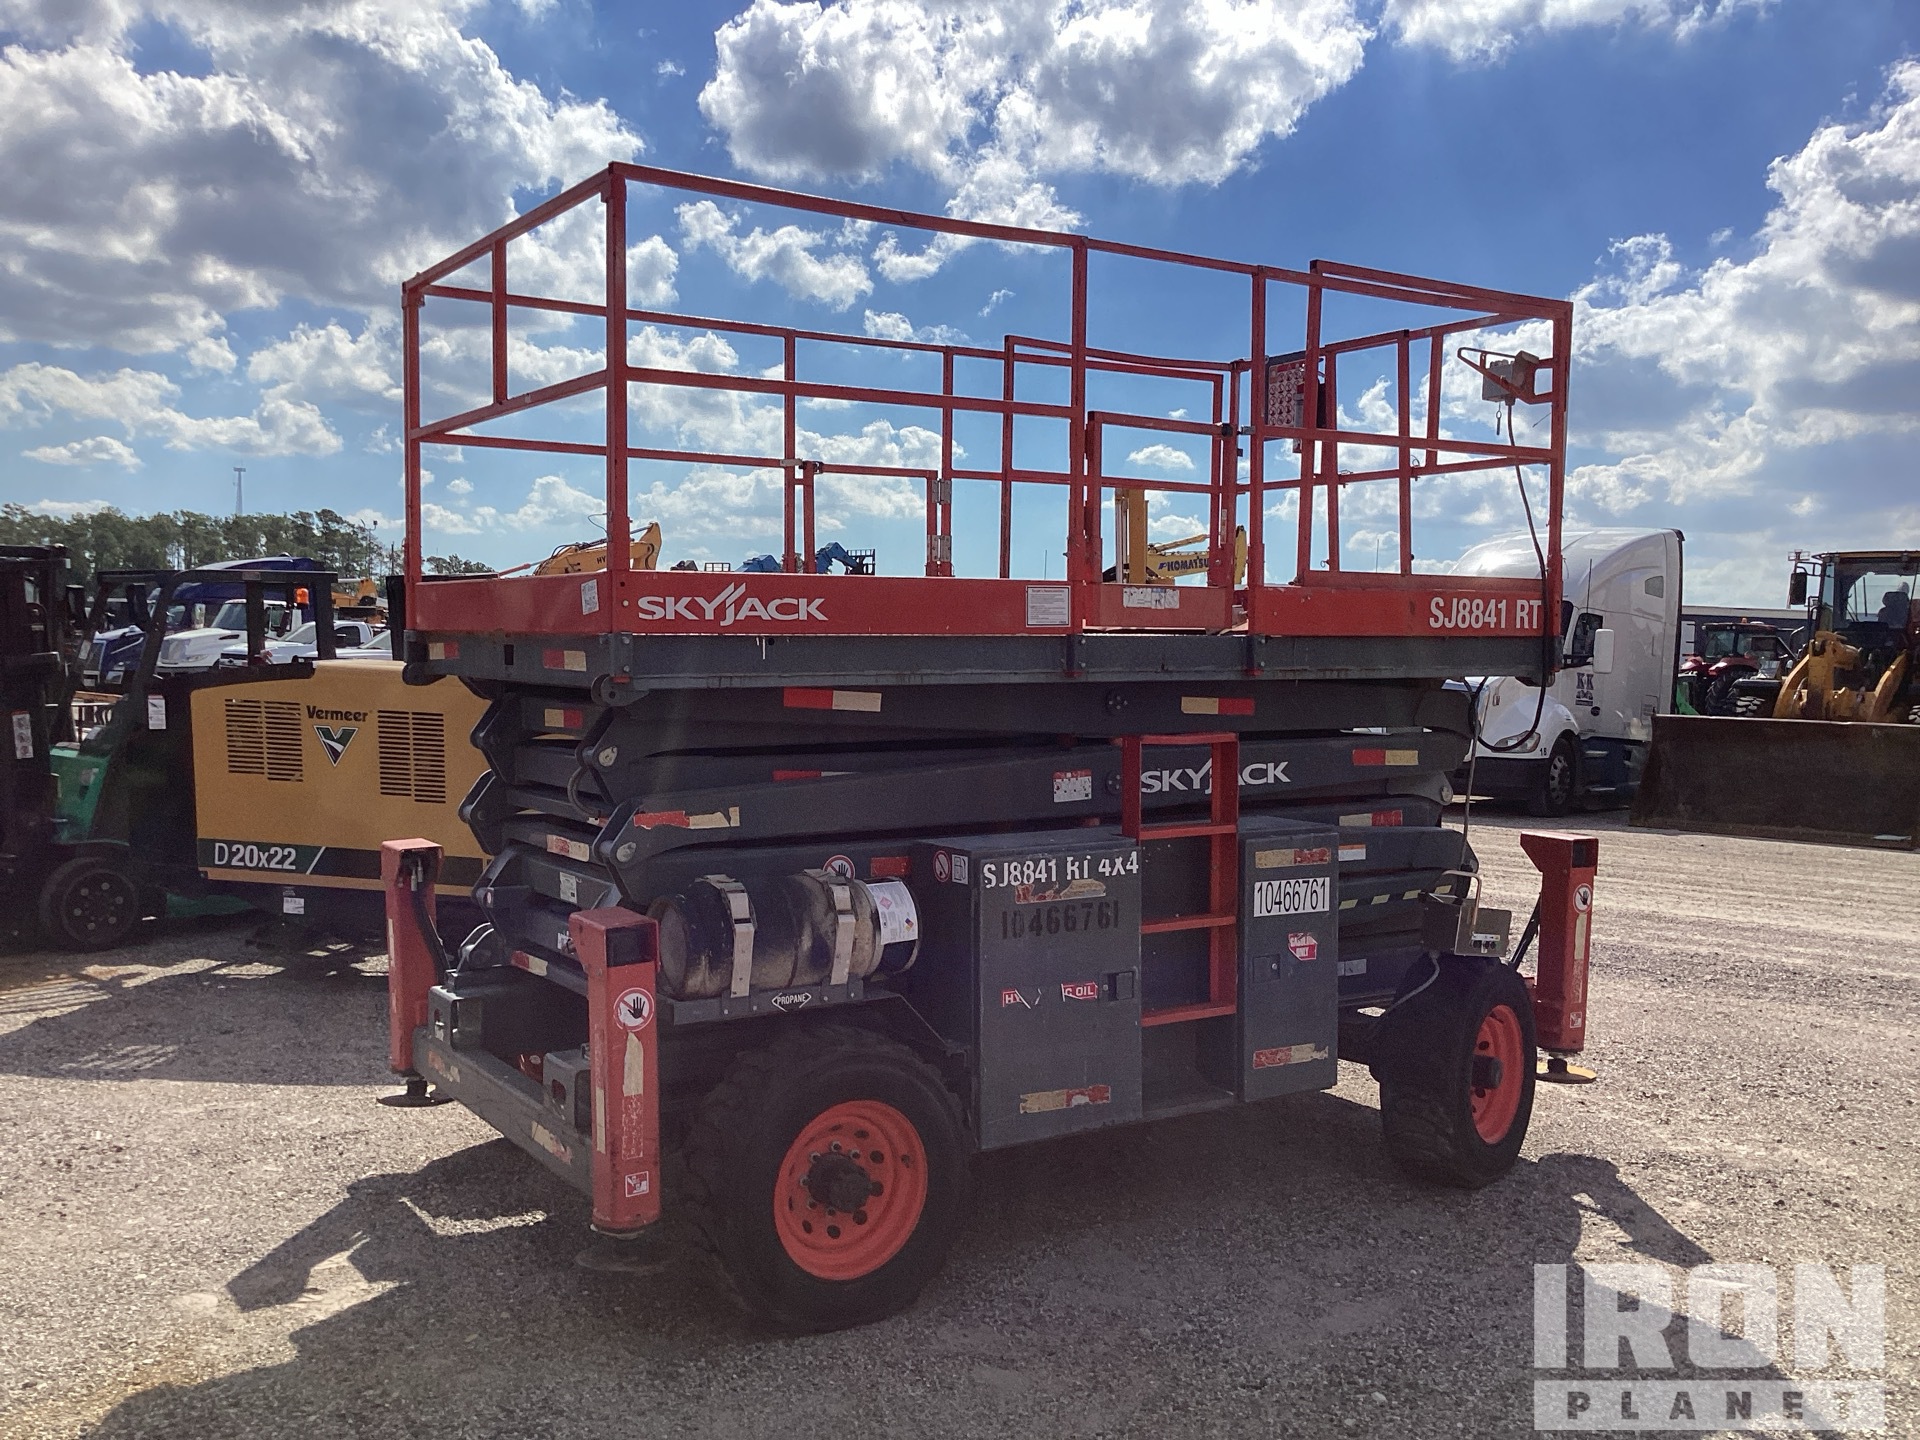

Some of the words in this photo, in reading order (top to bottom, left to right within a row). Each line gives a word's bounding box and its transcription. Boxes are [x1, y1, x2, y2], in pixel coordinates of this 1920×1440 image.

[637, 582, 829, 626] SKYJACK
[1429, 597, 1506, 629] SJ8841
[1515, 599, 1541, 629] RT
[306, 705, 368, 722] Vermeer
[983, 859, 1057, 889] SJ8841
[1258, 878, 1325, 914] 10466761
[1002, 900, 1119, 940] 10466761
[777, 993, 806, 1005] PROPANE
[1075, 985, 1094, 997] OIL
